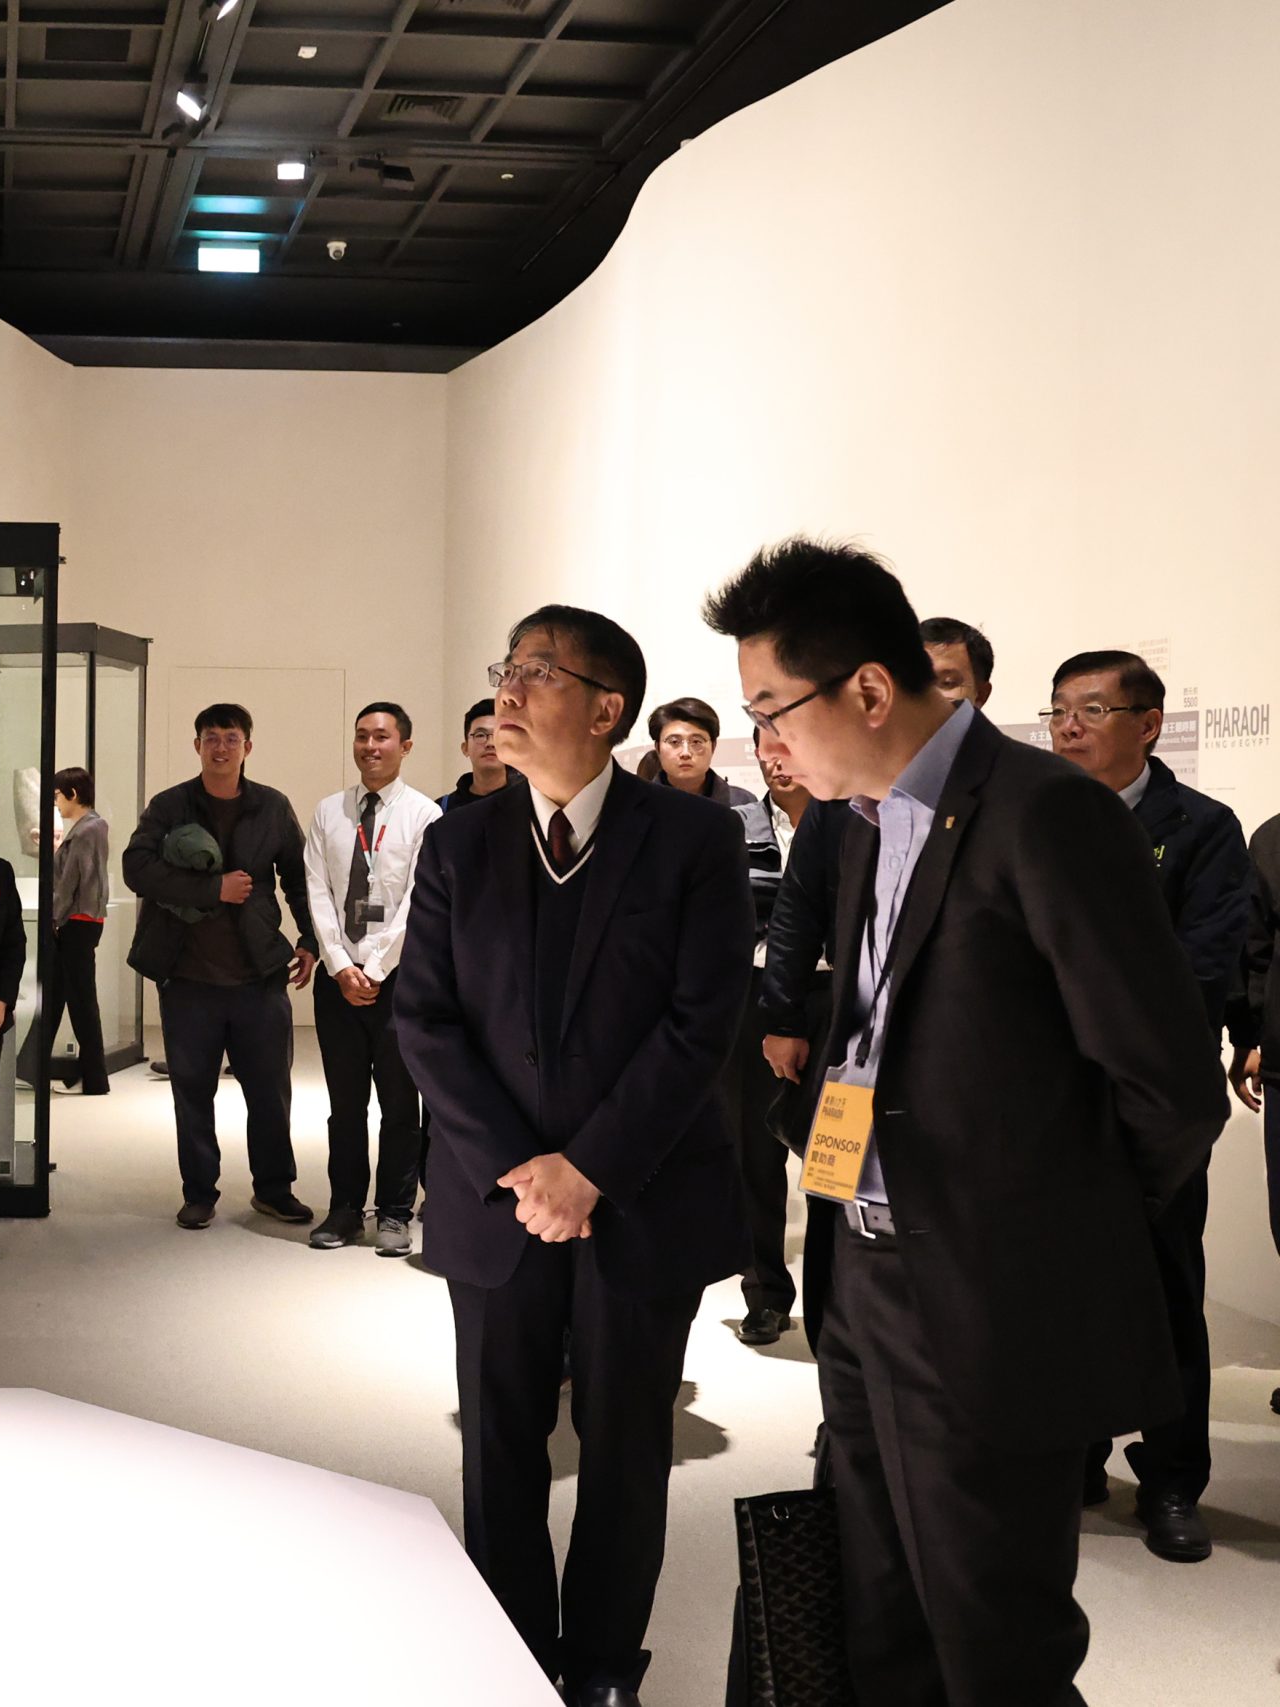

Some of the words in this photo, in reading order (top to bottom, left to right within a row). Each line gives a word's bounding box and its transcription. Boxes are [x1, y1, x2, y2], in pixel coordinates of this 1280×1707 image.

[1205, 704, 1270, 739] PHARAOH
[1205, 740, 1228, 749] KING
[1239, 737, 1270, 747] EGYPT
[814, 1133, 862, 1155] SPONSOR
